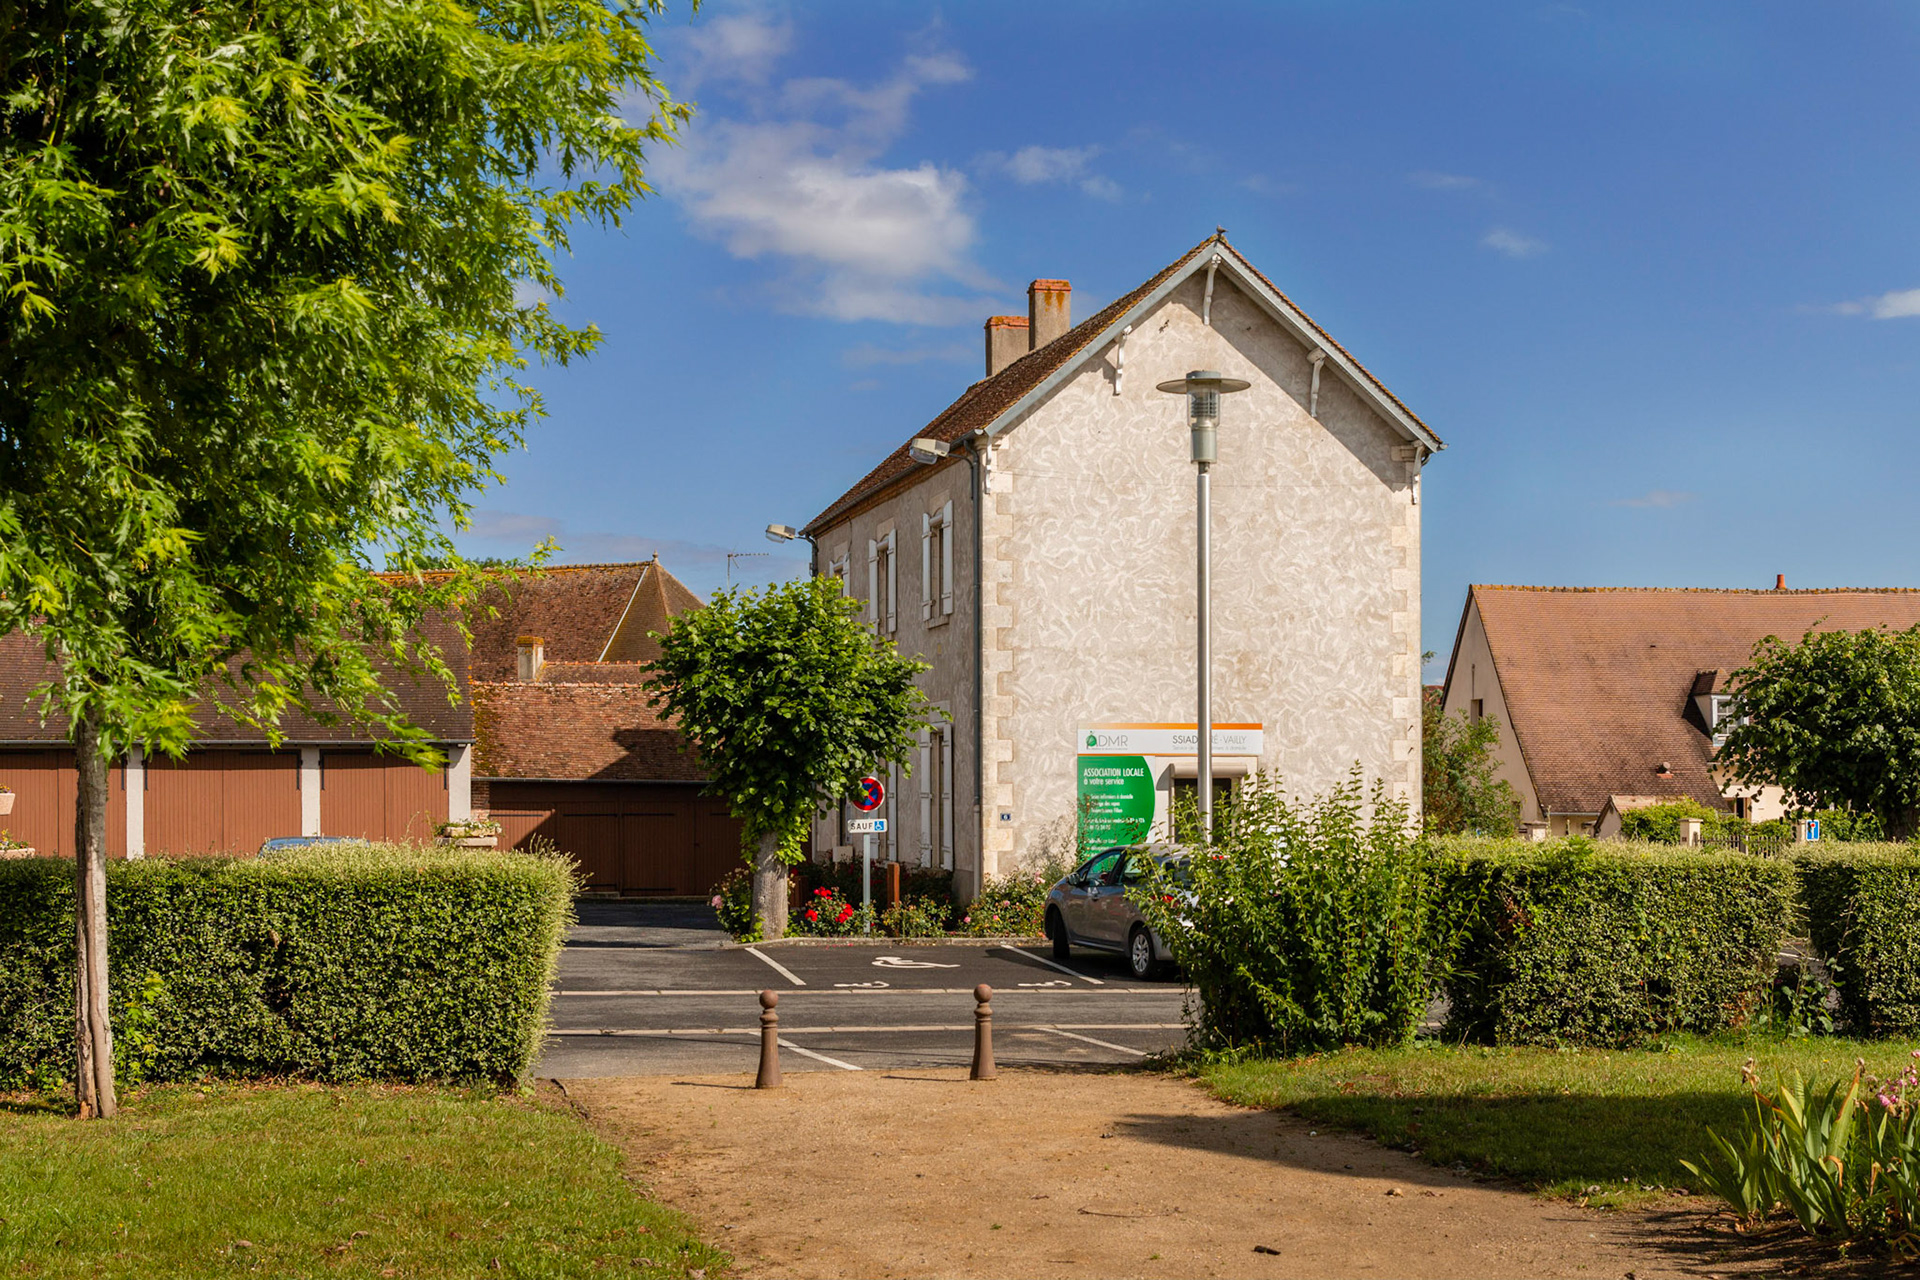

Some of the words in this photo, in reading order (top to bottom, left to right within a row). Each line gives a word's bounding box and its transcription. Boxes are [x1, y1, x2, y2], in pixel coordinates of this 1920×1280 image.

[1172, 735, 1199, 744] SSIAD
[1223, 735, 1247, 744] VAILLY
[1083, 768, 1121, 777] ASSOCIATION
[1123, 768, 1144, 777] LOCALE
[1105, 777, 1124, 785] service
[850, 822, 873, 830] SAUF
